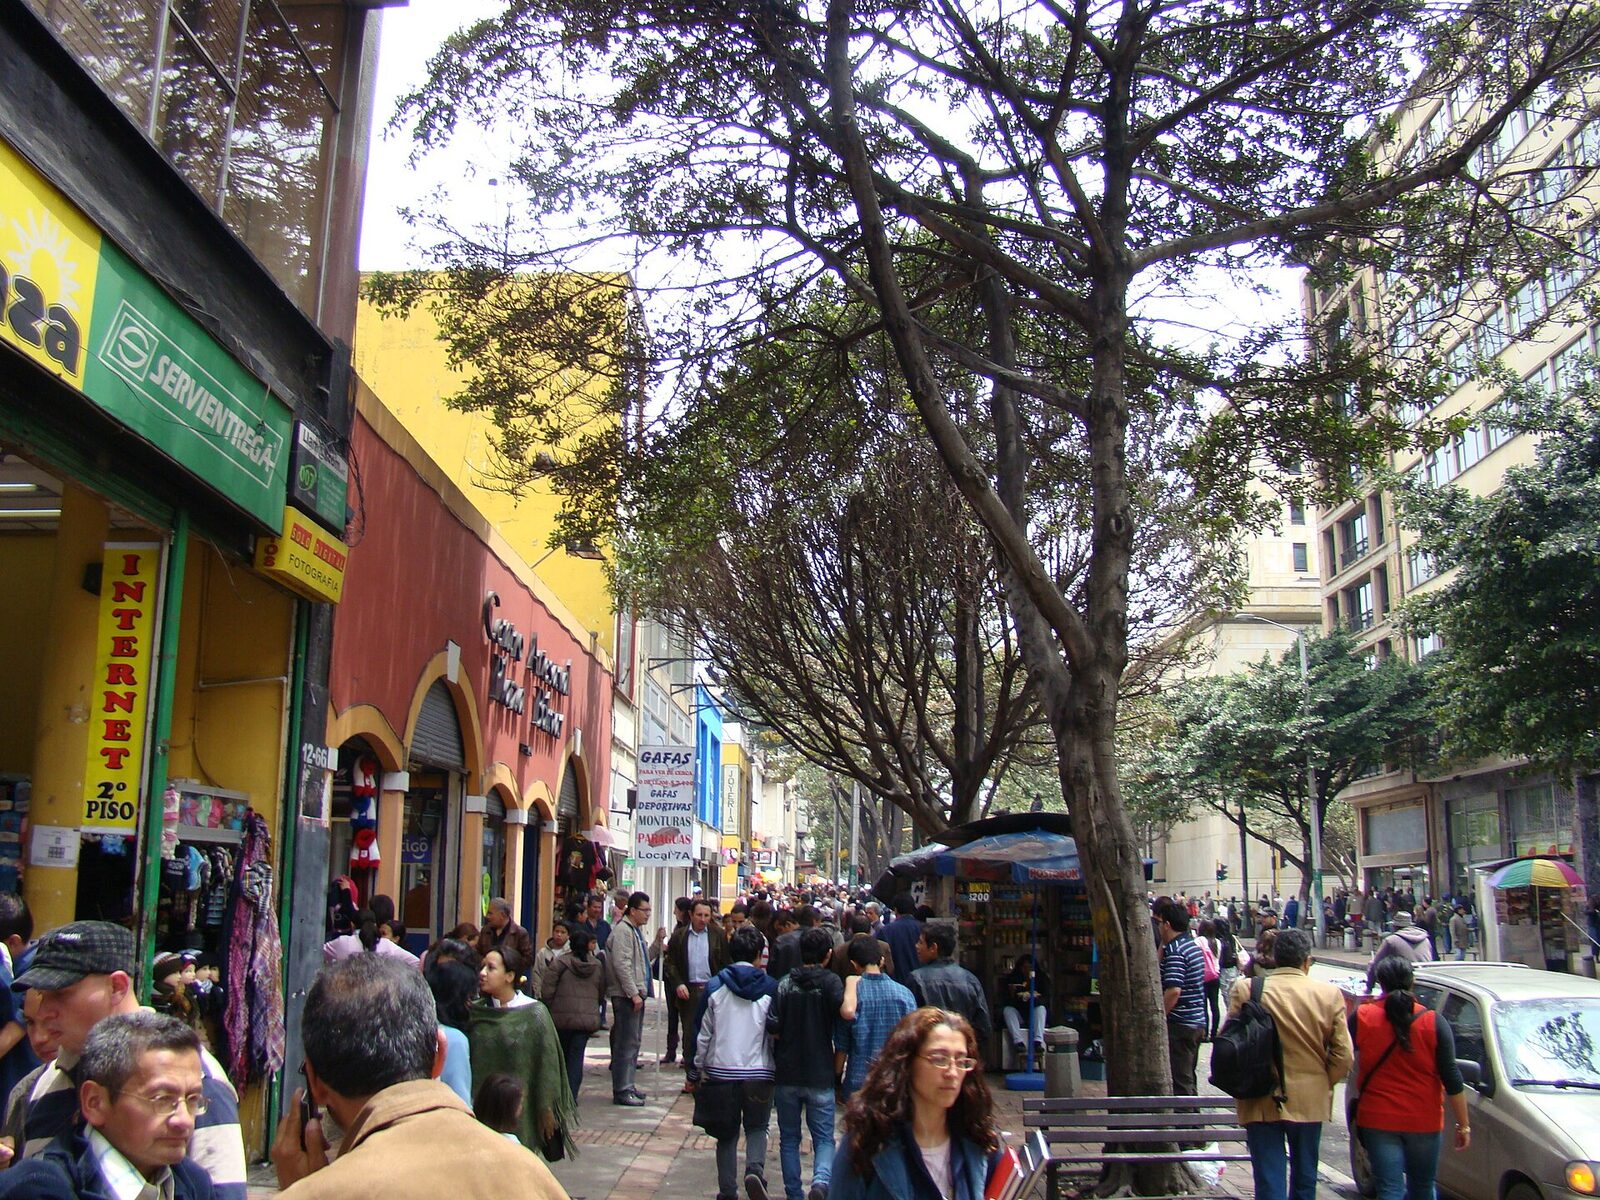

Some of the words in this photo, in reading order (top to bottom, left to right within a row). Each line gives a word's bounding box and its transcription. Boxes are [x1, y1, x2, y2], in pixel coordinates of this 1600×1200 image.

[150, 355, 275, 472] SERVIENTREGA
[289, 553, 339, 593] FOTOGRAFIA
[100, 554, 147, 769] INTERNET
[303, 743, 327, 768] 12-66
[641, 751, 692, 764] GAFAS
[651, 790, 677, 798] GAFAS
[86, 800, 134, 820] PISO
[638, 802, 692, 811] DEPORTIVAS
[639, 815, 691, 827] MONTURAS
[638, 832, 691, 845] PARAGUAS
[638, 850, 670, 860] Local
[675, 852, 690, 860] 7A
[969, 892, 990, 902] $200
